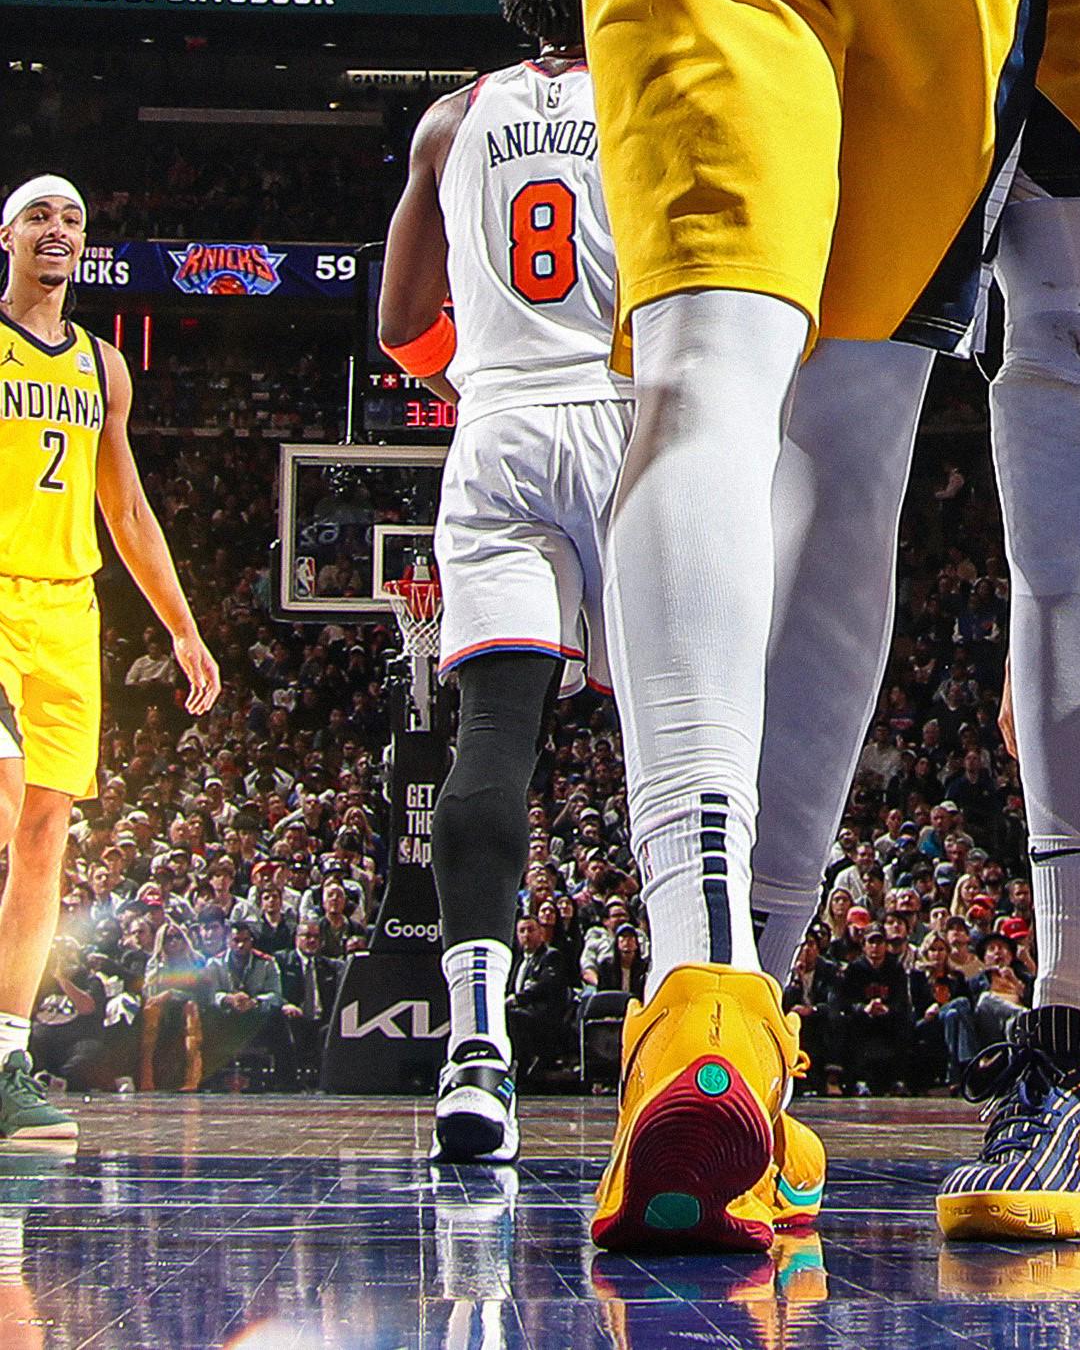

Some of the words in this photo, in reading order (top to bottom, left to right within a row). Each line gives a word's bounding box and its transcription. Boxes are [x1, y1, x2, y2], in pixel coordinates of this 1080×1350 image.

[510, 177, 579, 305] 8
[177, 243, 276, 280] KNICKS
[315, 255, 357, 280] 59
[405, 400, 457, 427] 3:30
[38, 427, 66, 493] 2
[406, 783, 436, 809] GET
[406, 810, 434, 835] THE
[340, 1000, 451, 1039] KI
